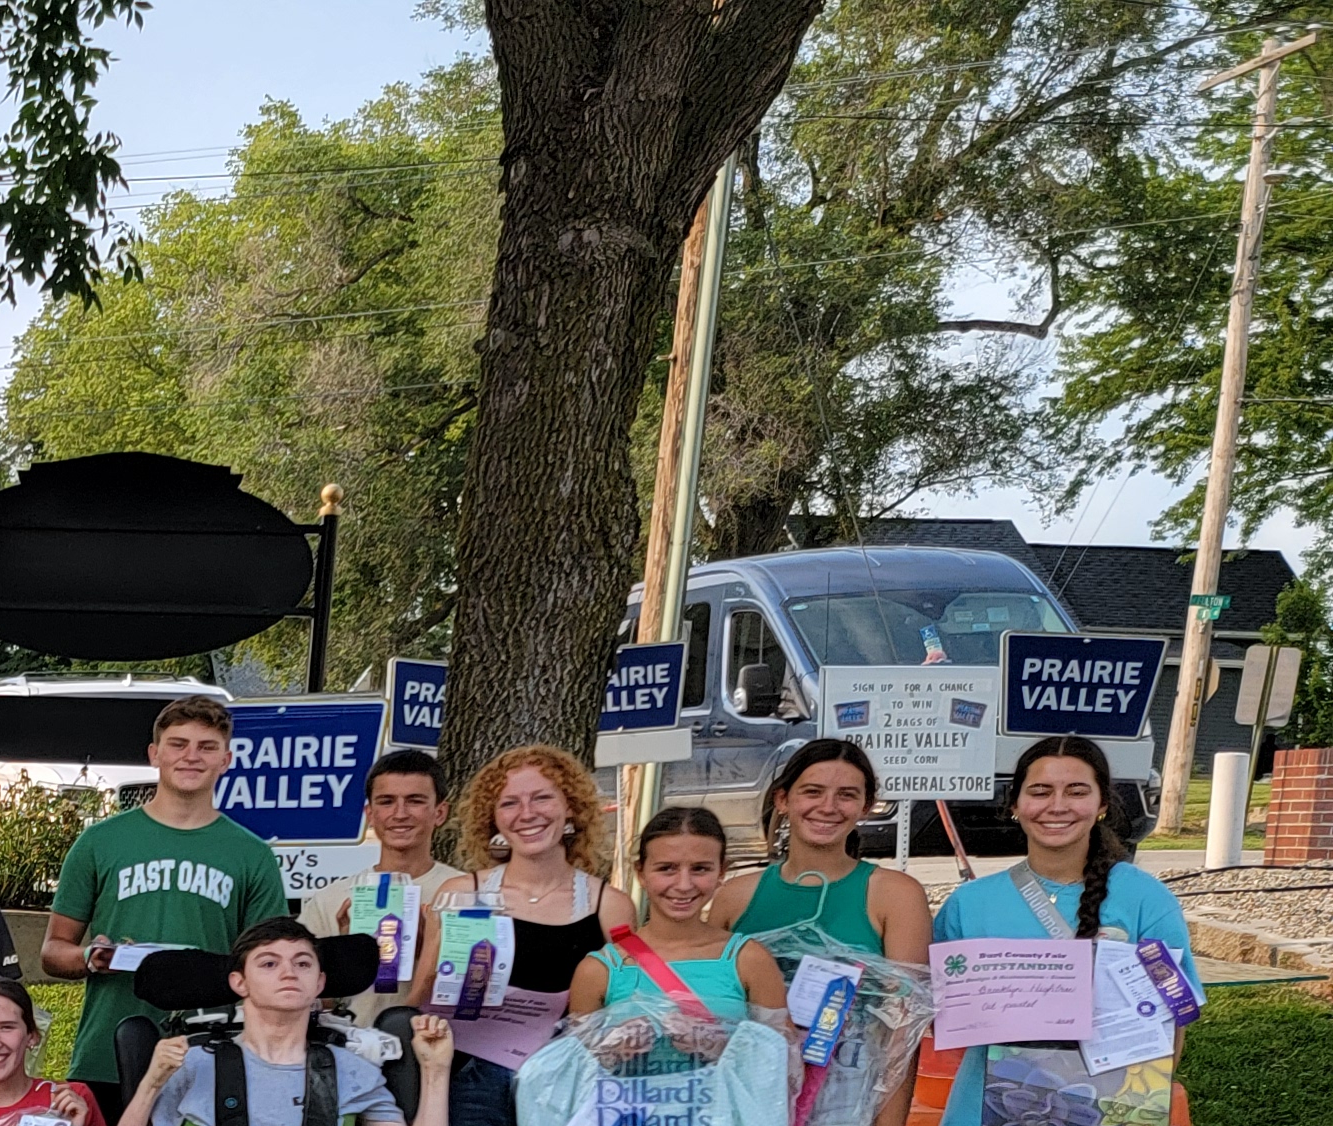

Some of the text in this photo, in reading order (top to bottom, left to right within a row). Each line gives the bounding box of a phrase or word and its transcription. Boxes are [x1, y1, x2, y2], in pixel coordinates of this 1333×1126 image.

[606, 663, 670, 688] AIRIE
[1022, 658, 1143, 685] PRAIRIE
[852, 683, 974, 692] SIGN UP FOR A CHANCE
[601, 686, 669, 713] LLEY
[892, 700, 932, 709] TO WIN
[1022, 685, 1137, 714] VALLEY
[403, 704, 442, 728] VAL
[883, 713, 937, 727] 2 BAGS OF
[845, 732, 969, 749] PRAIRIE VALLEY
[883, 755, 938, 765] SEED CORN
[885, 776, 992, 792] GENERAL STORE
[118, 859, 233, 909] EAST OAKS
[972, 963, 1074, 973] OUTSTANDING
[596, 1078, 714, 1105] Dillard's
